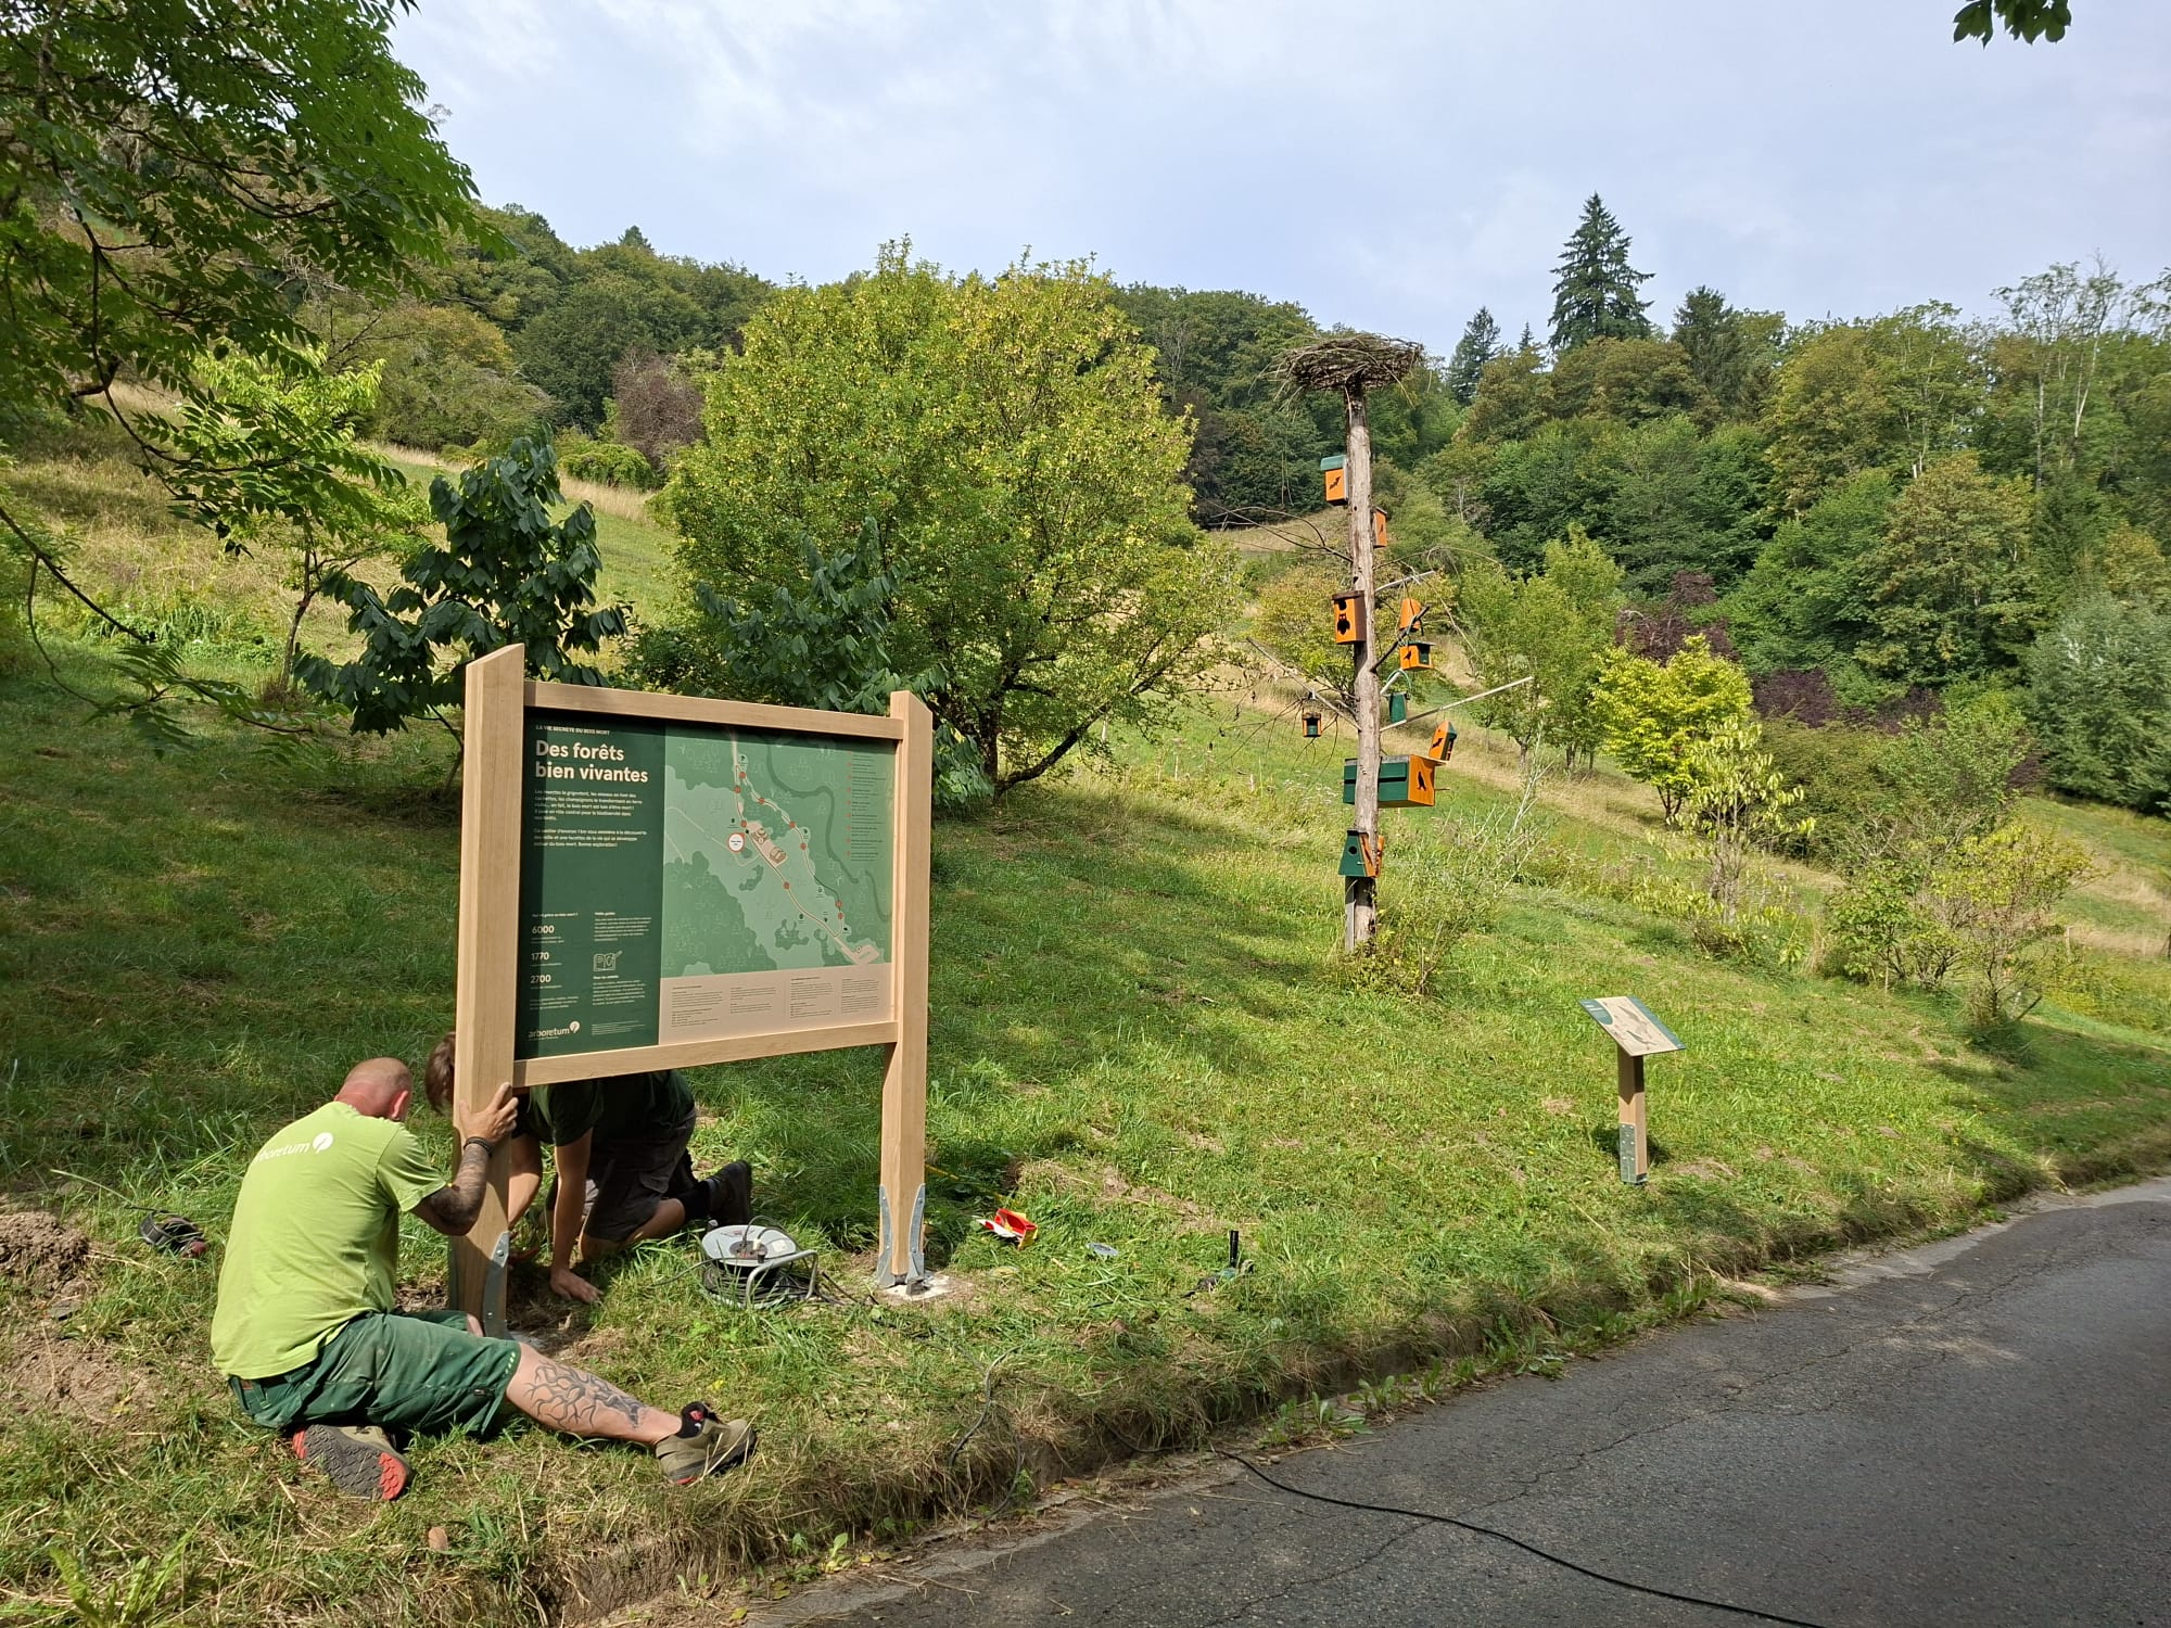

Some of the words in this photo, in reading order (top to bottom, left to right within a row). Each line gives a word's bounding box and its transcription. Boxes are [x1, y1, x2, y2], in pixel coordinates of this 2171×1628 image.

[536, 740, 569, 758] Des
[573, 742, 624, 761] forêts
[535, 761, 575, 779] bien
[579, 763, 649, 783] vivantes
[531, 925, 555, 934] 6000
[531, 952, 550, 961] 1770
[530, 974, 551, 984] 2700
[529, 1028, 570, 1038] arboretum
